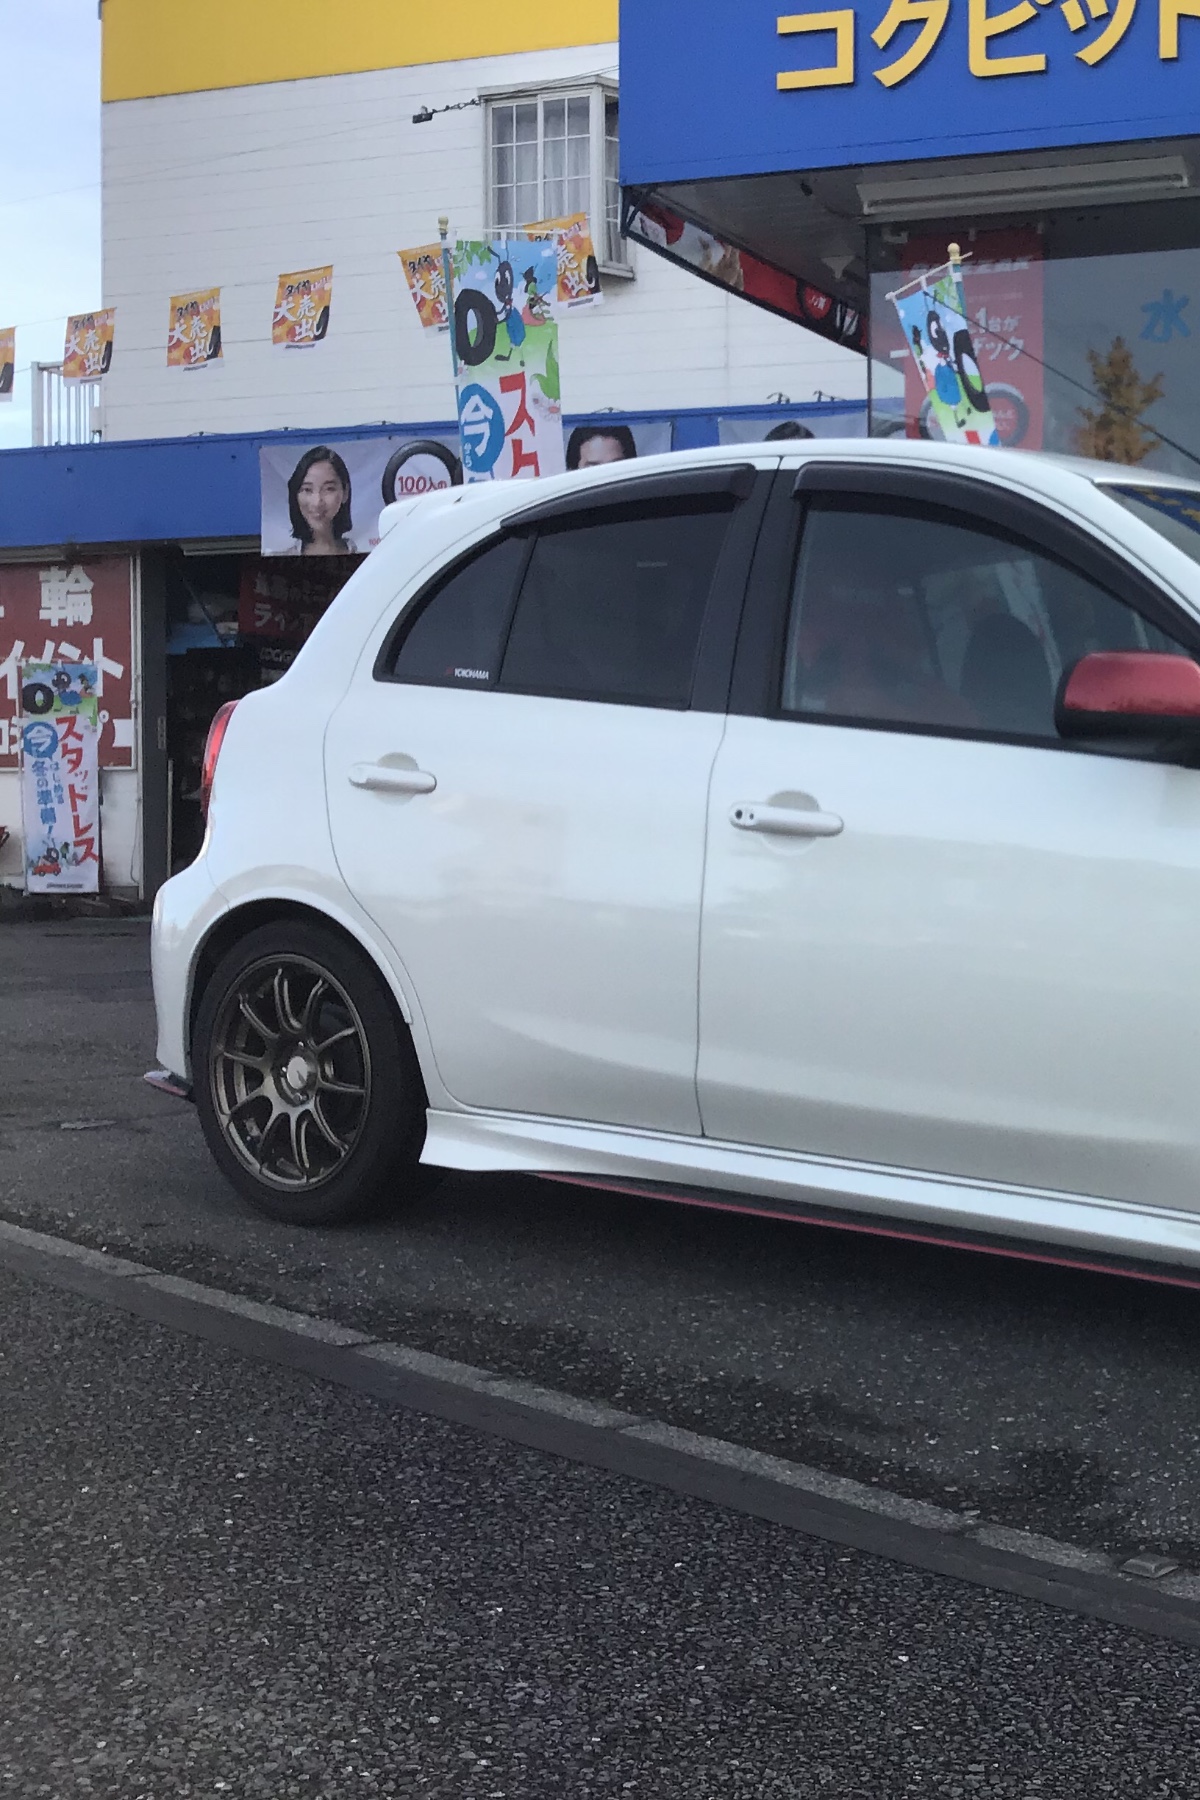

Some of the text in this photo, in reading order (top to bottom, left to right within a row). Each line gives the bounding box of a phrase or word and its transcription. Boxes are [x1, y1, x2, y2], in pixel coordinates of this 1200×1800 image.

[454, 668, 489, 680] YOKOHAMA
[55, 715, 99, 864] スタッドレス
